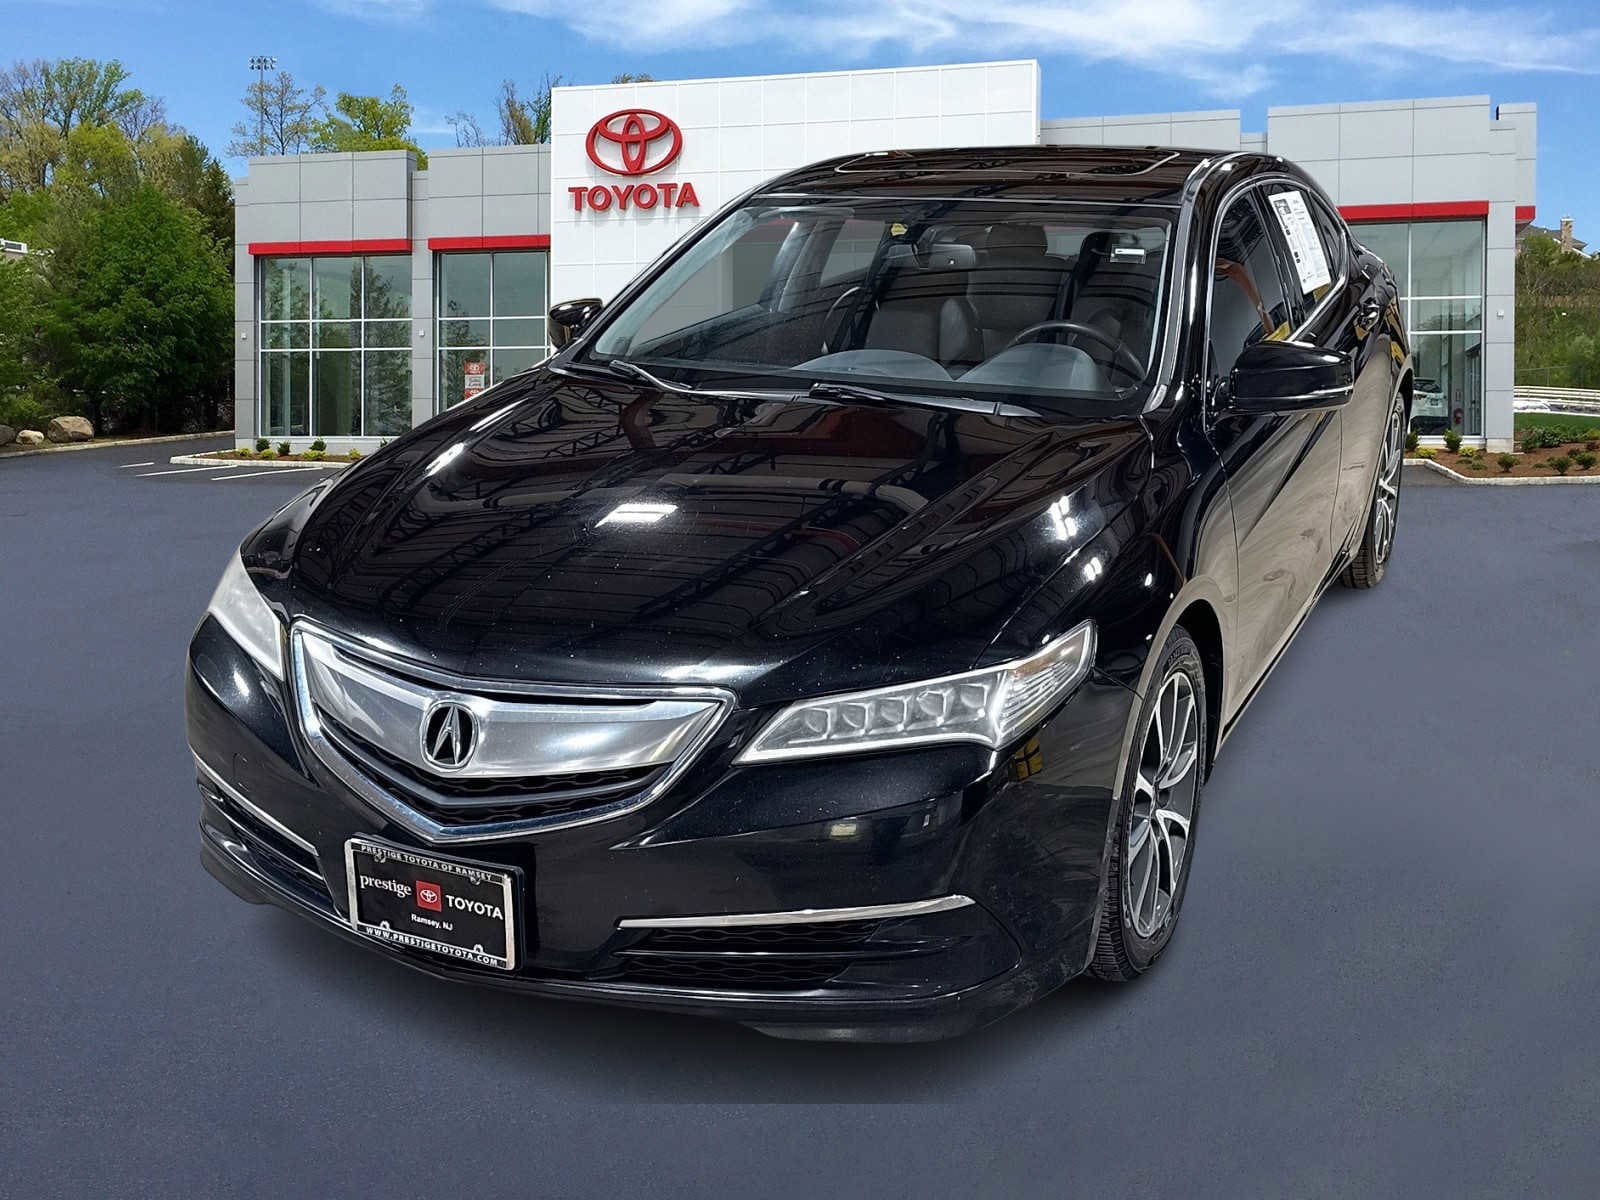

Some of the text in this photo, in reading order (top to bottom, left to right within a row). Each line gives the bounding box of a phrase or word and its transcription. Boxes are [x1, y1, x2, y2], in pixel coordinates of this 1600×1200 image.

[568, 182, 700, 211] TOYOTA
[361, 845, 492, 881] PRESTIGE TOYOTA OF RAMSEY
[359, 875, 504, 921] prestige TOYOTA
[411, 913, 454, 931] Ramsey, NJ
[366, 927, 498, 966] WWW.PRESTIGETOYOTA.COM
